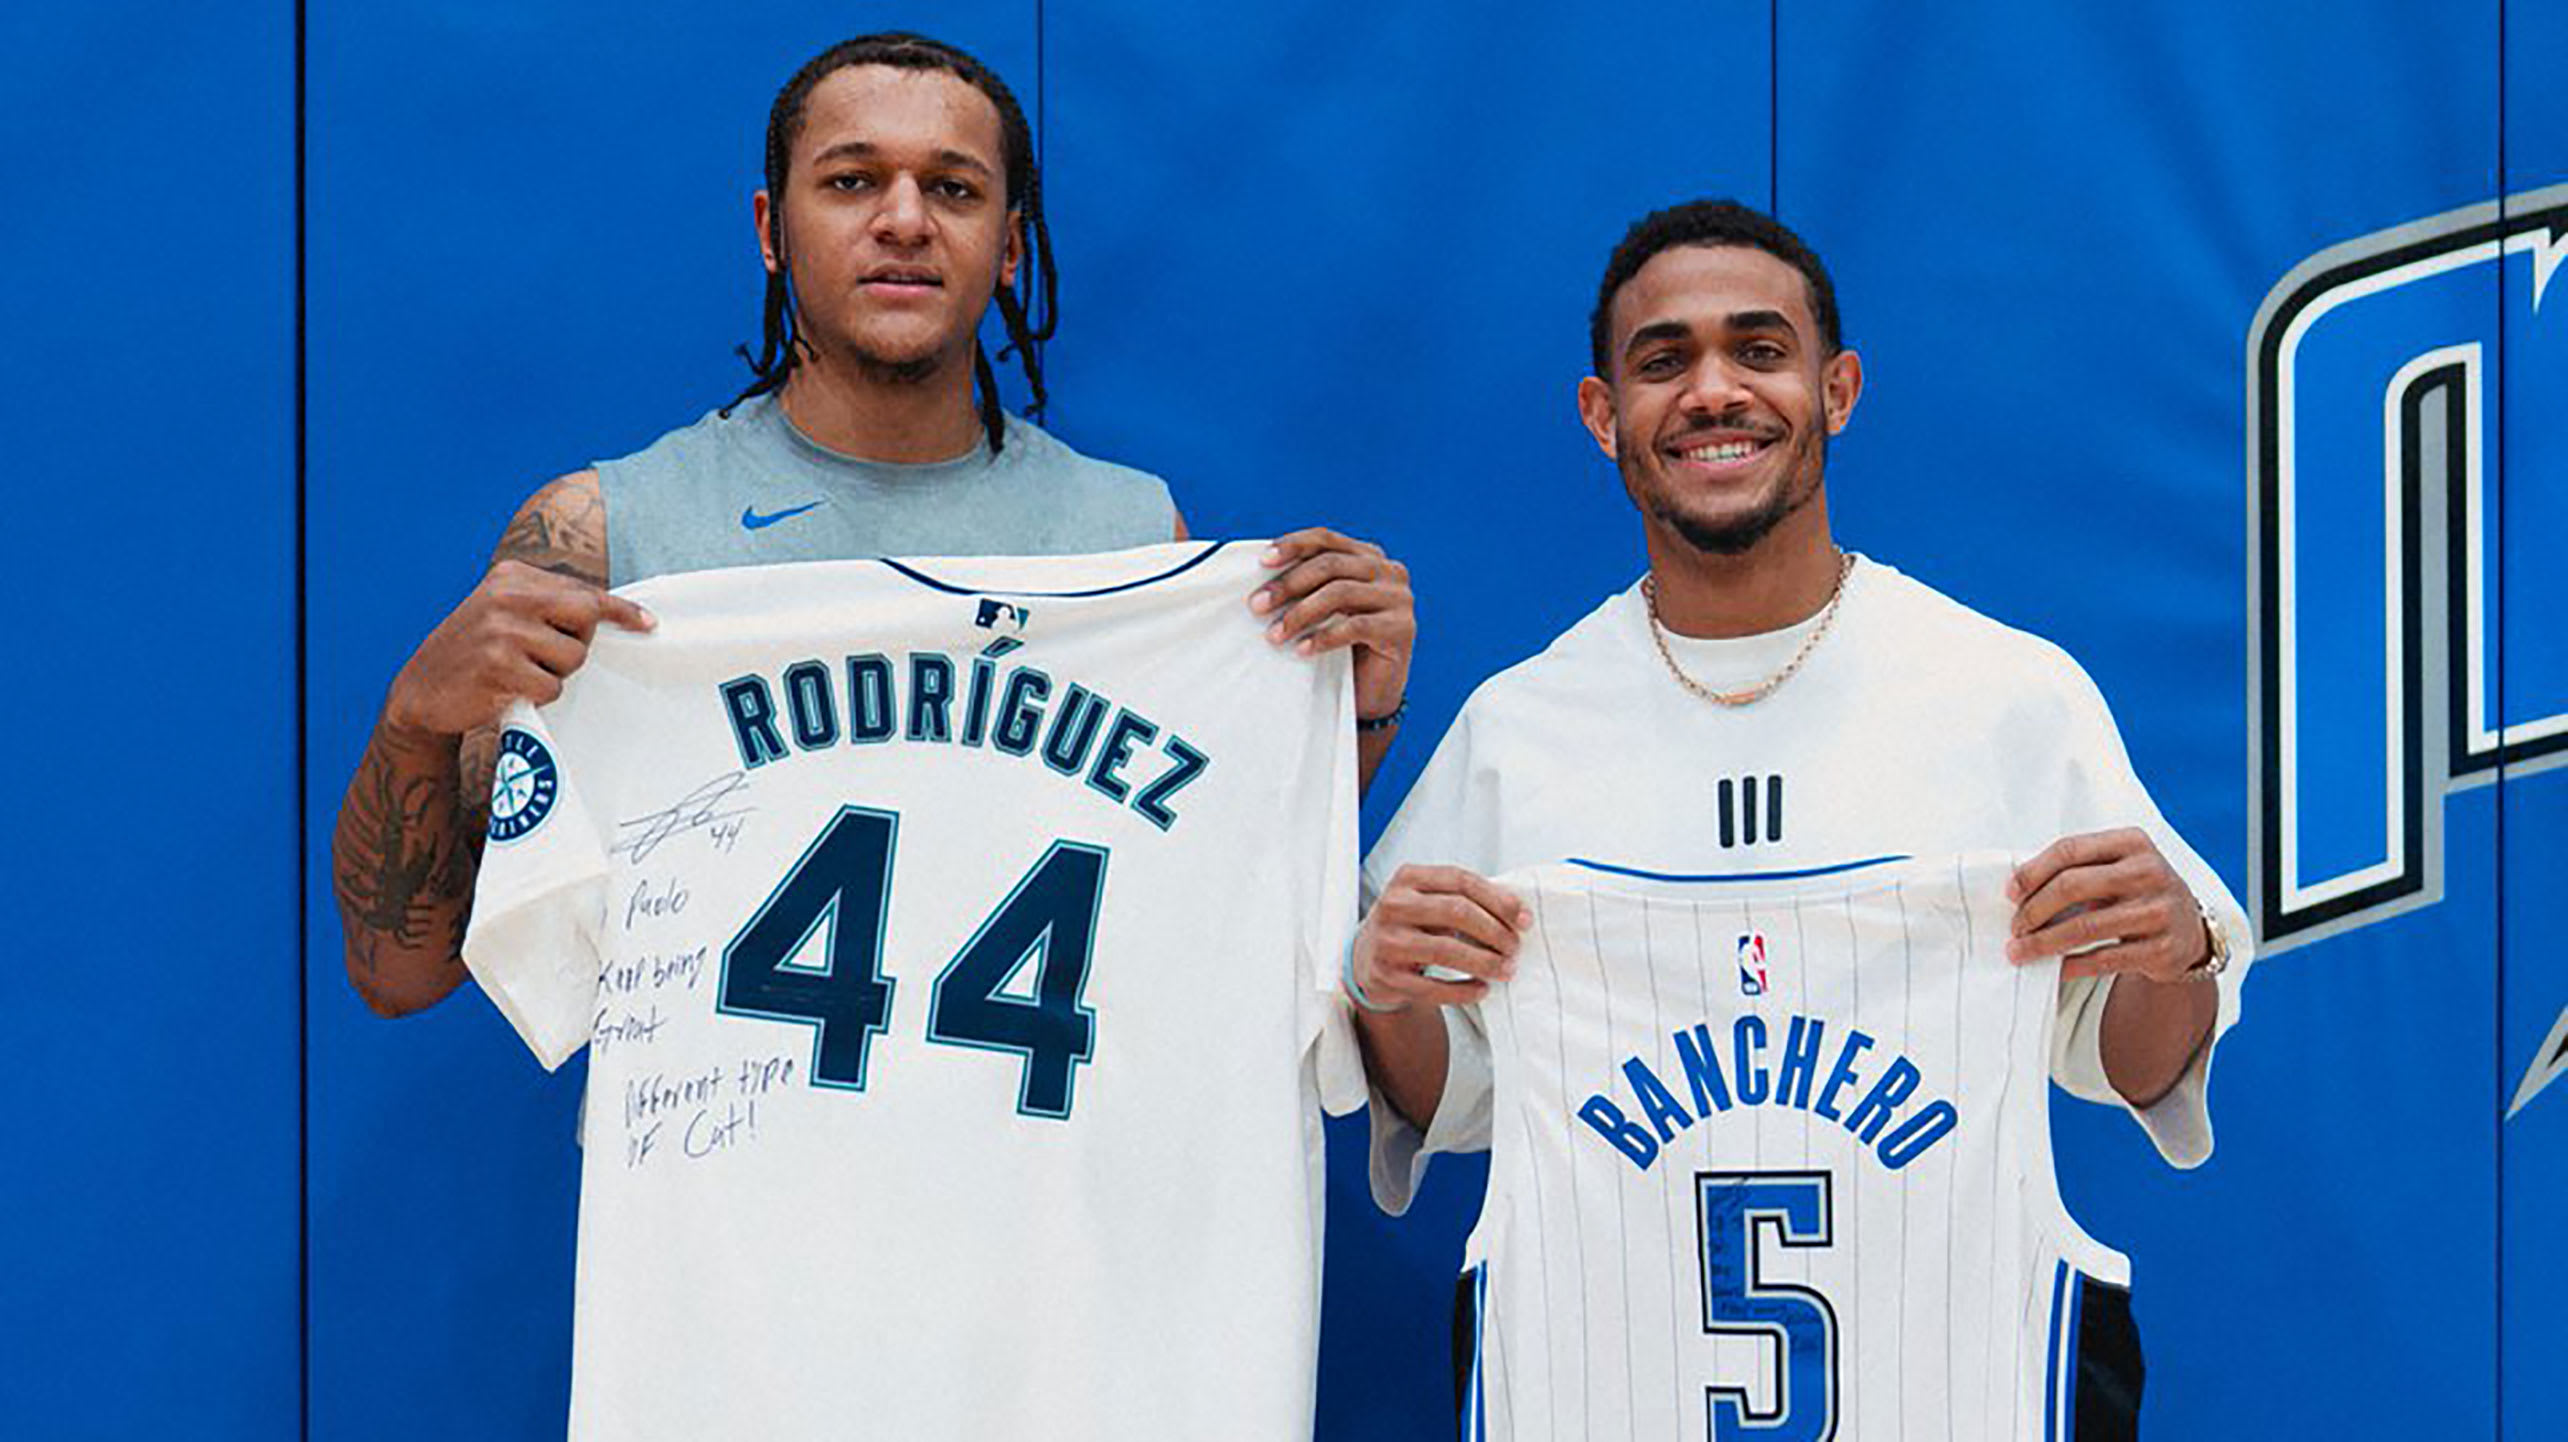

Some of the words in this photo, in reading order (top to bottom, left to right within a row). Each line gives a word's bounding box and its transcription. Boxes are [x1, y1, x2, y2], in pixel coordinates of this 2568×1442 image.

[719, 636, 1211, 832] RODRÍGUEZ
[711, 815, 745, 854] 44
[715, 804, 1111, 1121] 44
[1576, 1014, 1959, 1172] BANCHERO
[1694, 1169, 1839, 1442] 5
